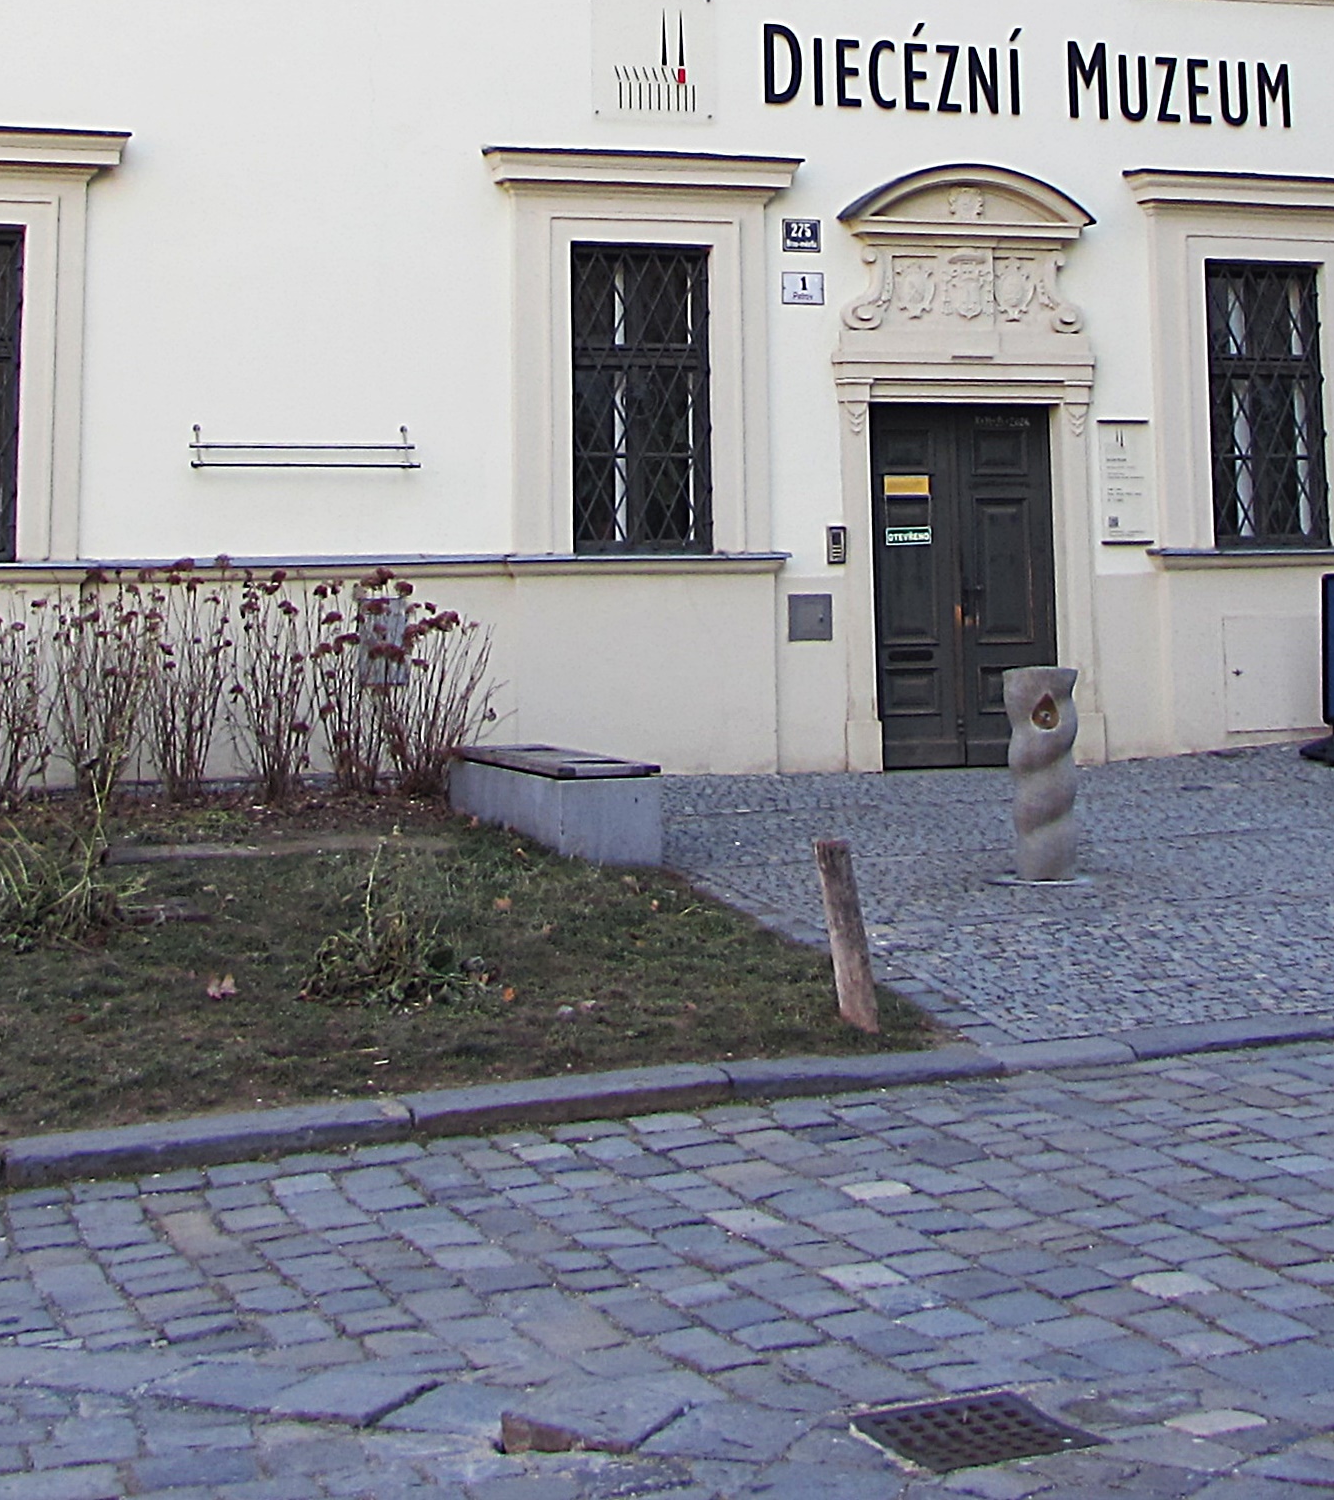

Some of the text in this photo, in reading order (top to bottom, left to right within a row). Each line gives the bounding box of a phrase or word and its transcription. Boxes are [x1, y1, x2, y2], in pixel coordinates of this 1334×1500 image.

[791, 222, 811, 238] 275
[800, 275, 808, 291] 1
[888, 531, 930, 542] OTEVŘENO
